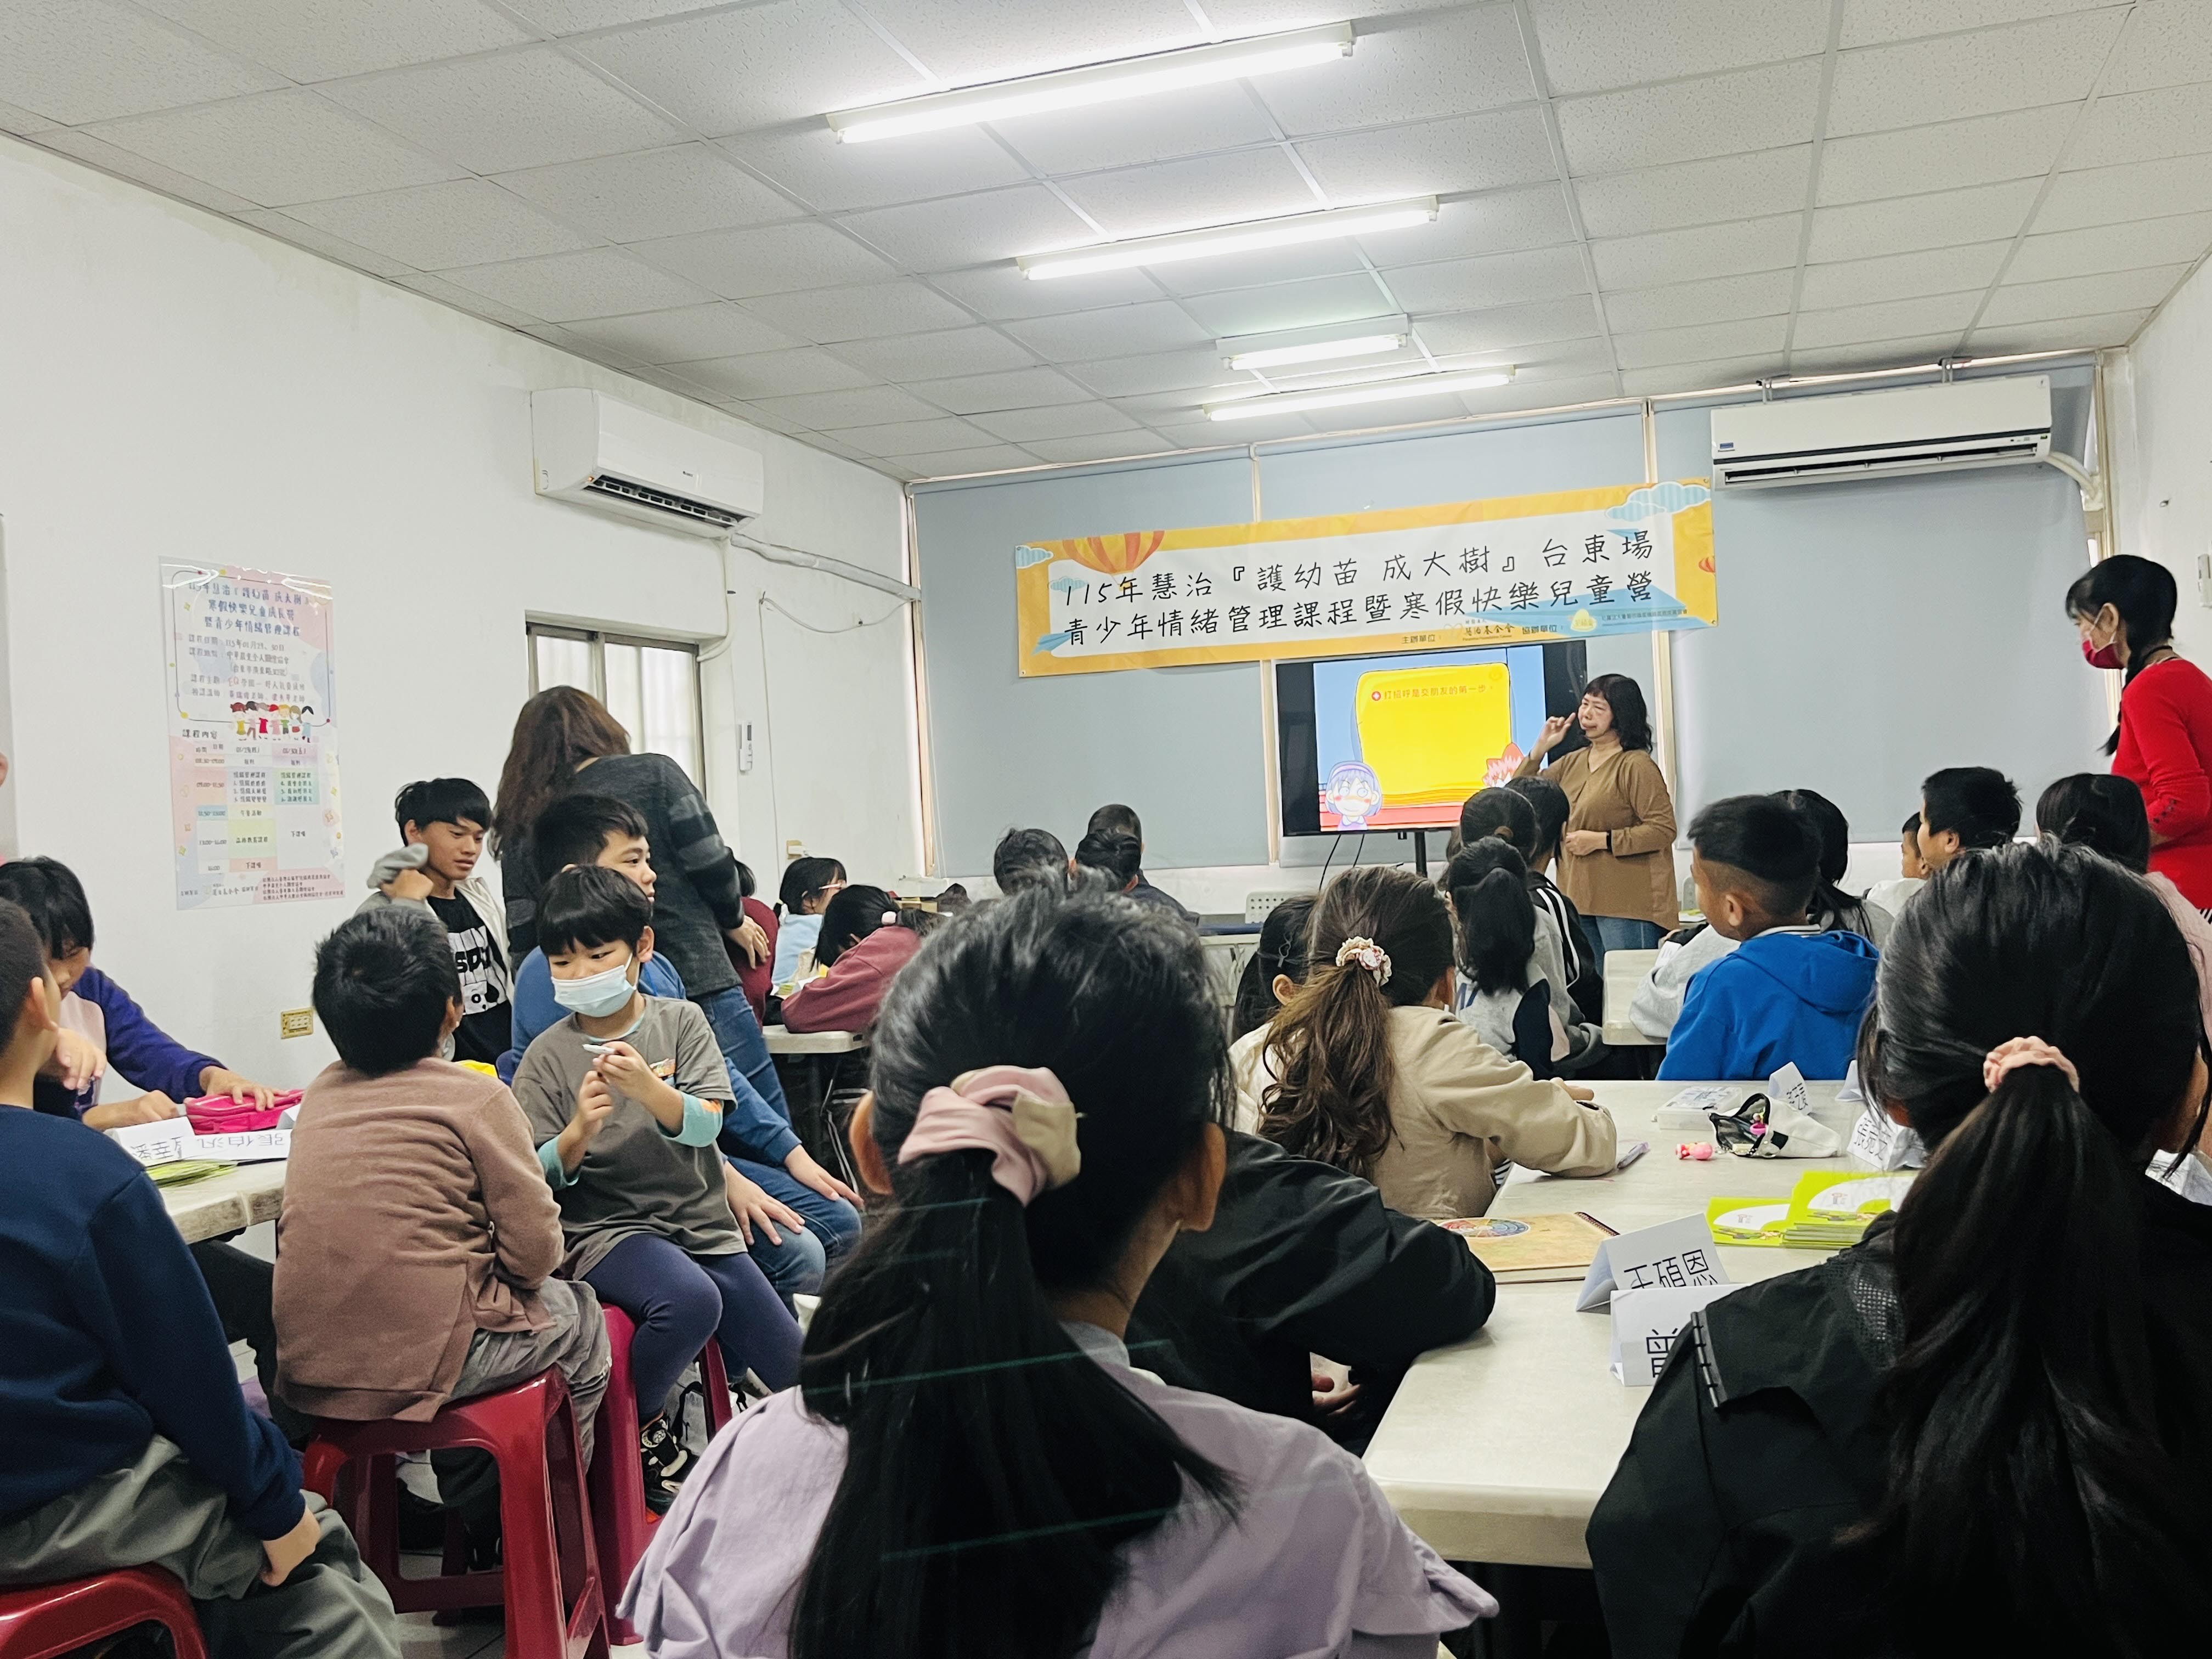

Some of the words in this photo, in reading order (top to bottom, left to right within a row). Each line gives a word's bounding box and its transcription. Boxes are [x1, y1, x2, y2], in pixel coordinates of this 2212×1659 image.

[1065, 557, 1358, 606] 115年慧治『護幼苗
[1383, 545, 1515, 582] 成大樹』
[1542, 530, 1653, 567] 台東場
[1064, 570, 1652, 645] 青少年情緒管理課程暨寒假快樂兒童營
